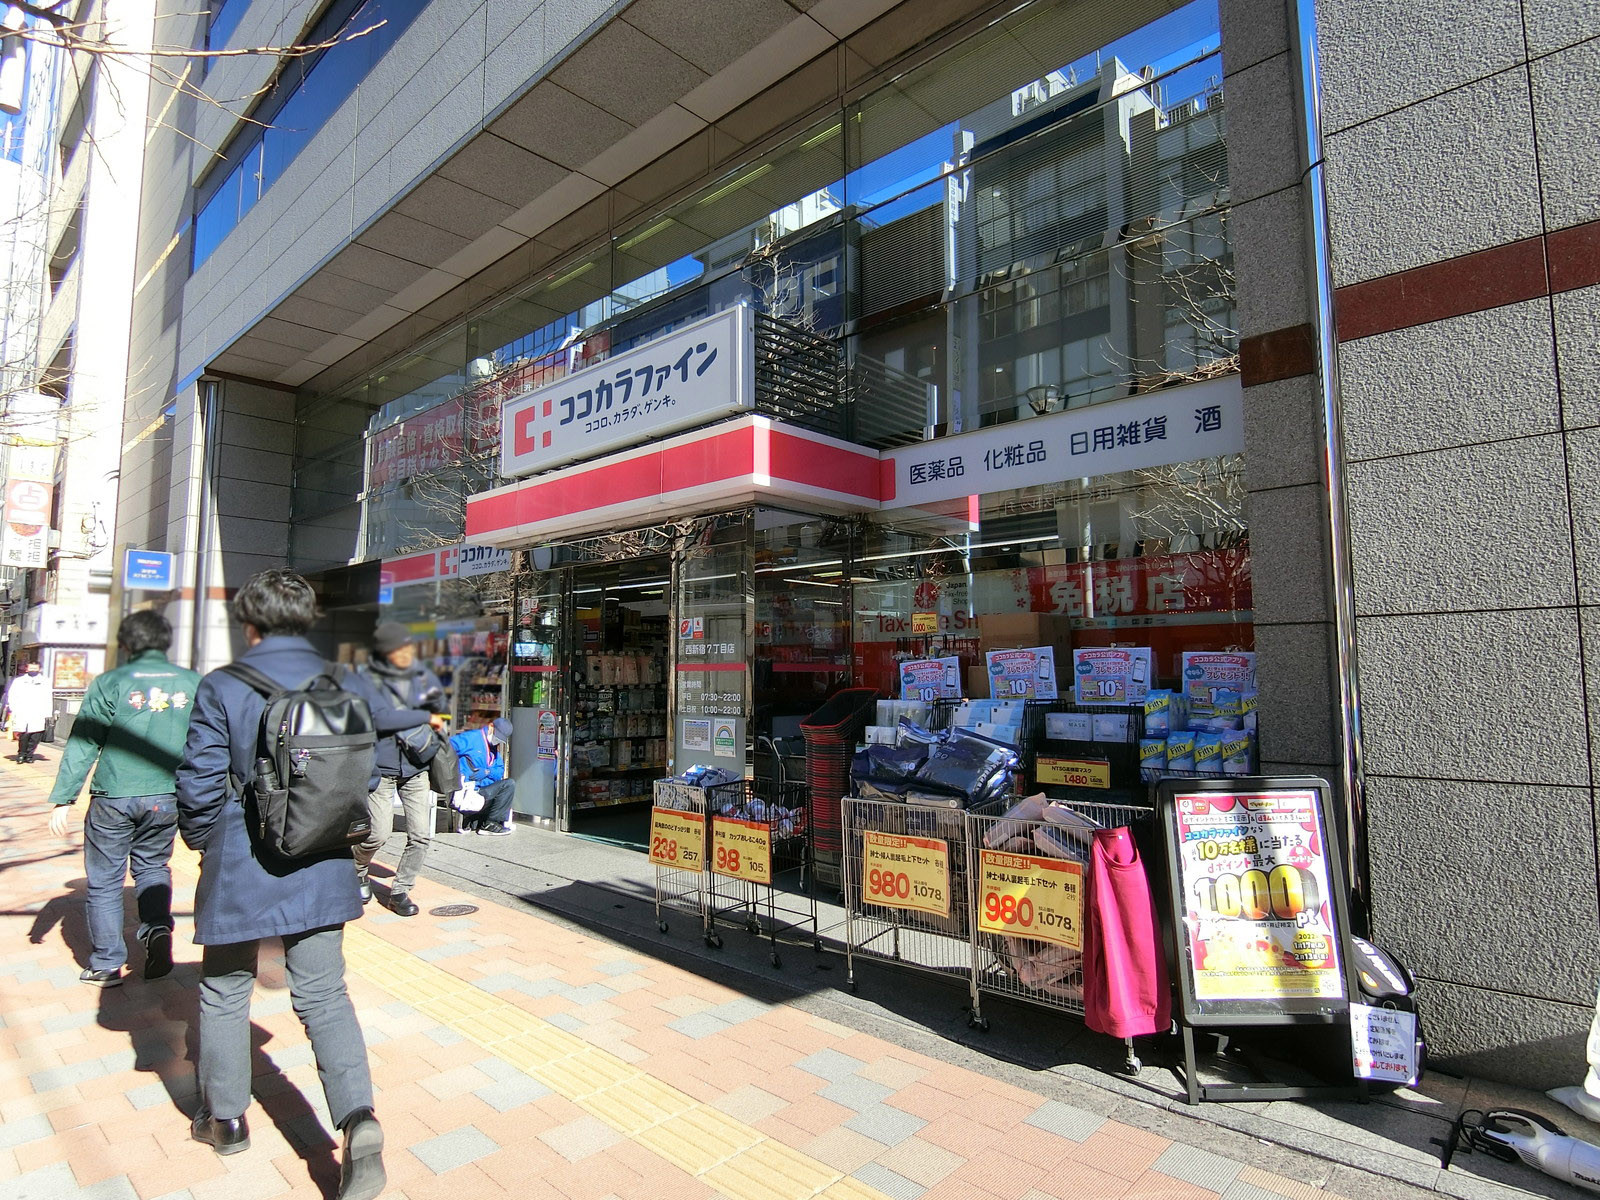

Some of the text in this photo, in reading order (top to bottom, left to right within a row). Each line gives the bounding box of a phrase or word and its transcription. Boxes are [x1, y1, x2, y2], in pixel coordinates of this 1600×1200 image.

[559, 341, 719, 426] ココカラファイン
[585, 397, 678, 434] ココロ、カラダ、ゲンキ。
[909, 404, 1223, 485] 医薬品 化粧品 日用雑貨 酒
[1049, 574, 1186, 617] 免税店
[1147, 699, 1164, 710] Fitty
[1142, 744, 1159, 755] Fitty
[1170, 744, 1187, 756] Fitty
[1197, 745, 1215, 757] Fitty
[1223, 742, 1241, 754] Fitty
[652, 836, 678, 861] 238
[682, 850, 699, 862] 257
[716, 846, 741, 873] 98
[749, 861, 764, 873] 105
[984, 853, 1031, 870] 数量限定!!
[869, 868, 911, 900] 980
[913, 883, 942, 902] 1,078
[1063, 883, 1077, 894] 各種
[984, 891, 1034, 928] 980
[1038, 911, 1072, 931] 1,078
